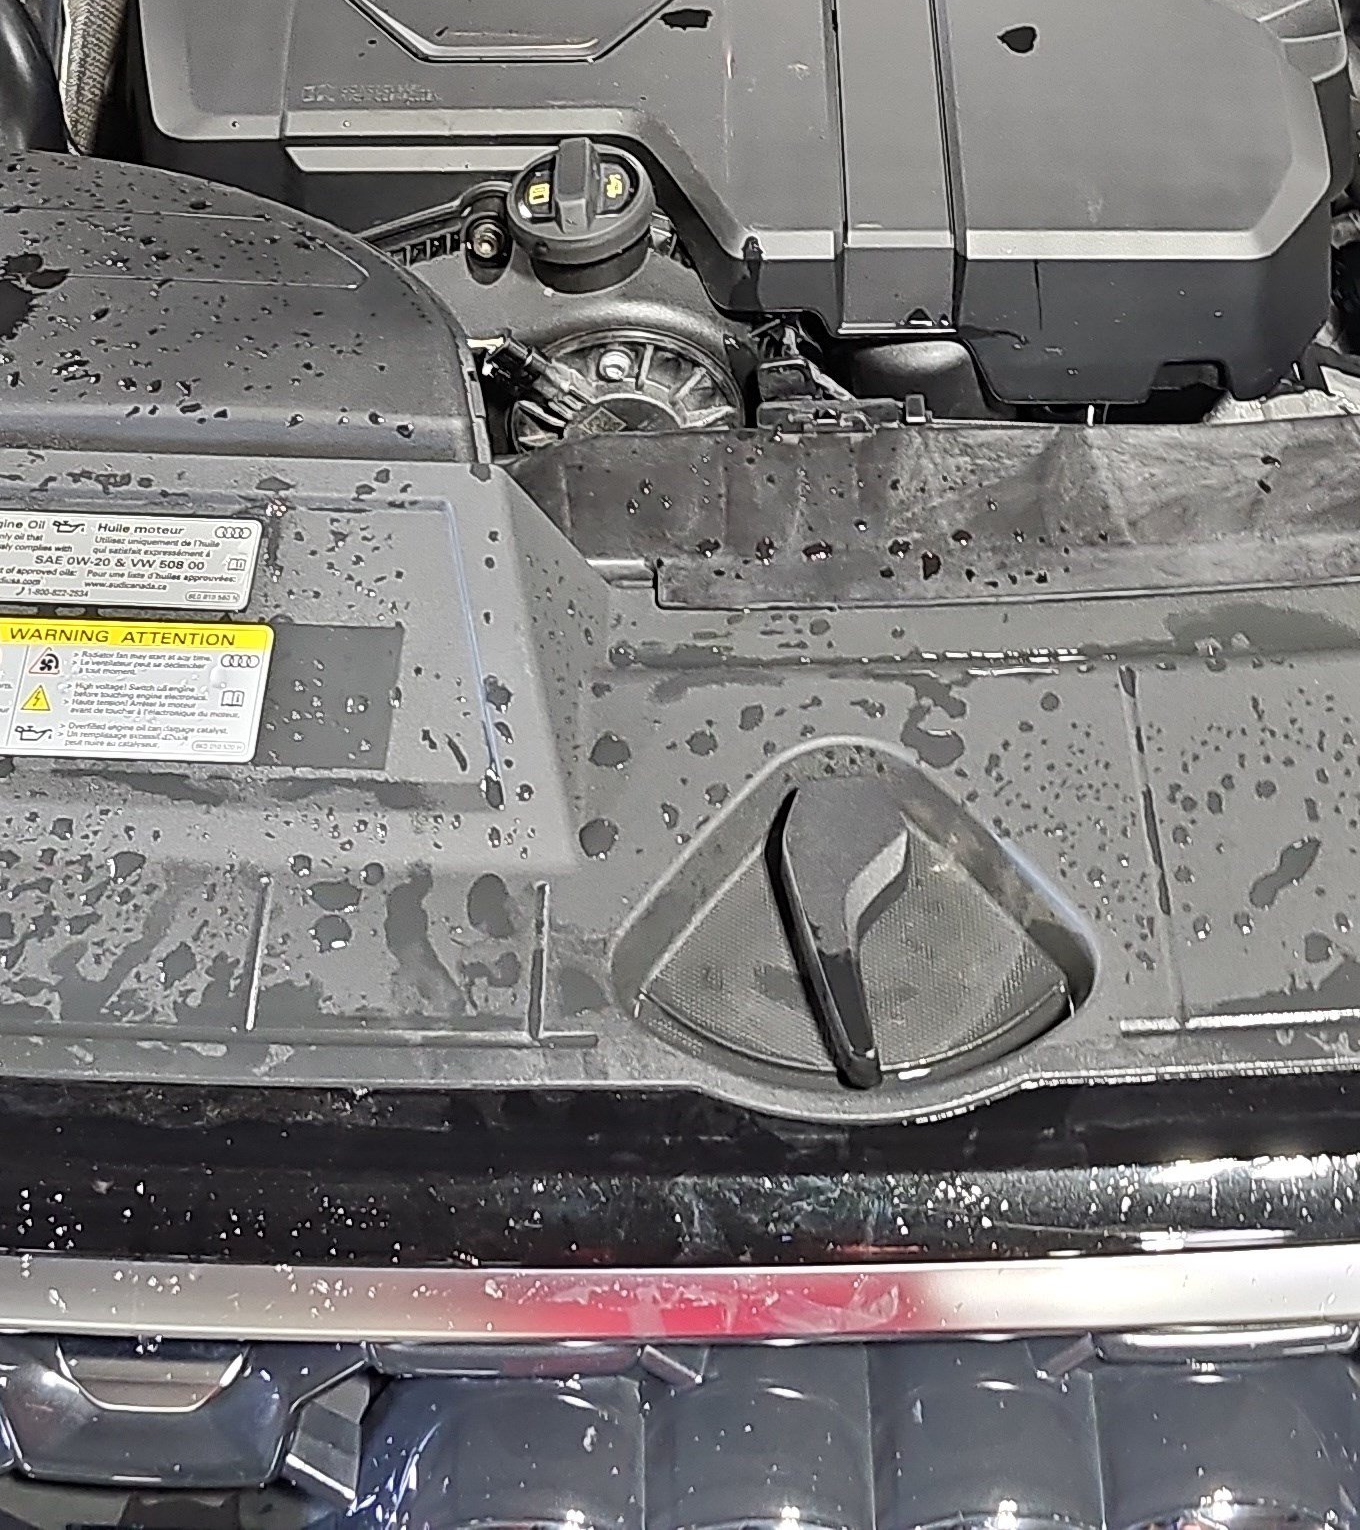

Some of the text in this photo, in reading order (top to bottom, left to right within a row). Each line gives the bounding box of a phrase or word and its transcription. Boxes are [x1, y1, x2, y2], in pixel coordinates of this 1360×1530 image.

[28, 520, 46, 529] Oil
[98, 523, 185, 535] Huile moteur
[95, 536, 125, 544] Utilisez
[128, 538, 179, 546] uniquement
[15, 543, 52, 552] complies
[92, 547, 107, 555] qui
[34, 555, 205, 570] SAE 0W-20 & VW 508 00
[6, 566, 15, 574] of
[17, 568, 57, 576] approved
[86, 570, 107, 578] Pour
[127, 571, 145, 579] liste
[9, 626, 237, 647] WARNING ATTENTION
[75, 683, 92, 691] High
[95, 683, 127, 692] voltage!
[168, 686, 195, 694] engine
[74, 691, 98, 699] before
[100, 692, 134, 700] touching
[136, 693, 162, 701] engine
[105, 707, 135, 715] toucher
[108, 724, 134, 732] engine
[136, 724, 146, 732] oil
[65, 739, 82, 747] peut
